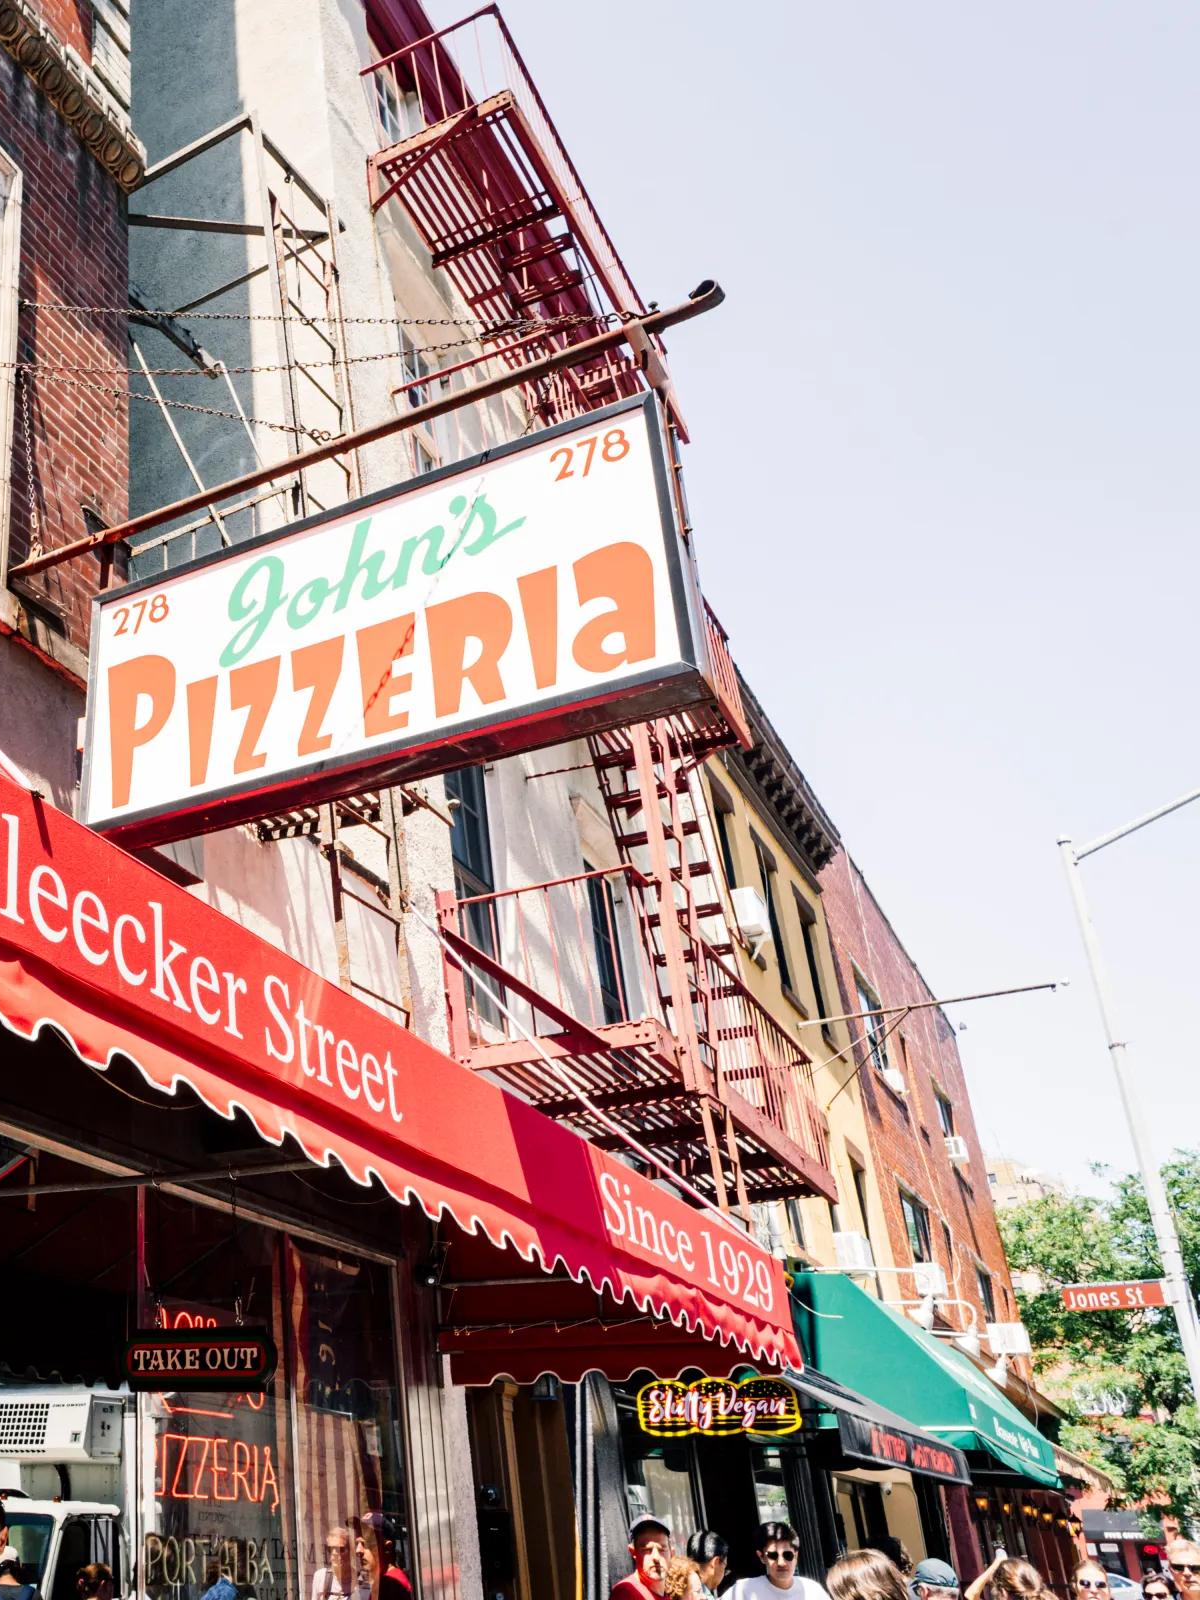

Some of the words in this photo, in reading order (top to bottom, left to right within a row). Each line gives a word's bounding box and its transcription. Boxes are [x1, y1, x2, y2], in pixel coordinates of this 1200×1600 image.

[548, 428, 631, 482] 278
[218, 491, 527, 667] John's
[112, 593, 169, 637] 278
[263, 975, 403, 1122] Street
[600, 1172, 695, 1272] Since
[700, 1230, 774, 1313] 1929
[1069, 1291, 1121, 1309] Jones
[1125, 1287, 1145, 1305] St
[133, 1349, 200, 1371] TAKE
[205, 1347, 258, 1370] OUT
[649, 1388, 712, 1430] Slutty
[709, 1385, 787, 1428] Vegan
[154, 1433, 279, 1513] IZZERIA
